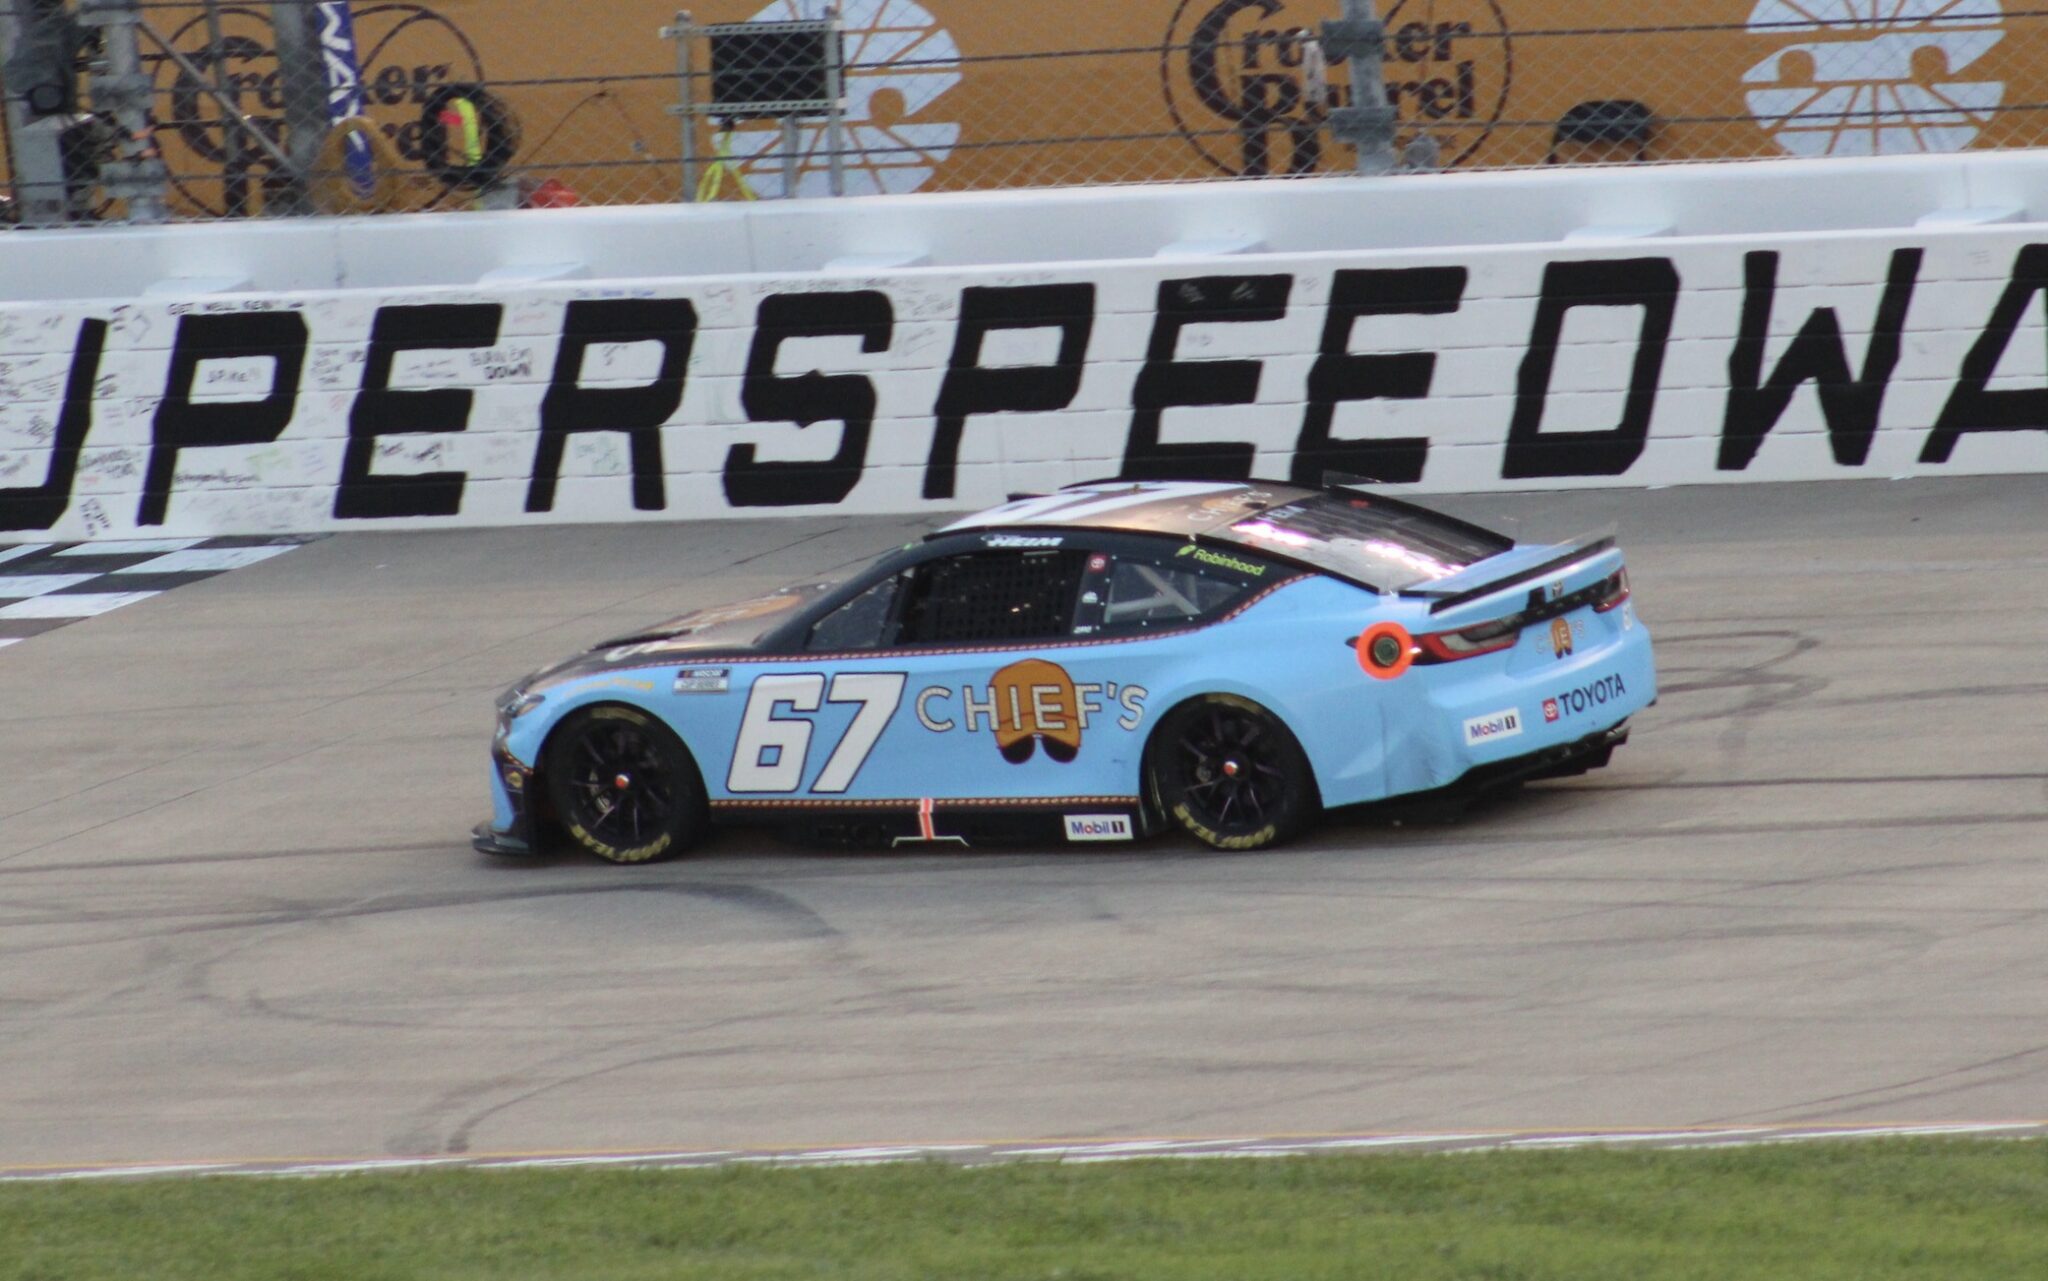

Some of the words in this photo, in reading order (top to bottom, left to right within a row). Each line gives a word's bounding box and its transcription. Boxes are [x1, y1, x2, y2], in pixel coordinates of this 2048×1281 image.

[1188, 0, 1472, 122] Craer
[172, 35, 453, 163] Craer
[1193, 548, 1266, 577] Robinhood
[915, 682, 1149, 733] CHIEF'S
[1559, 673, 1627, 717] TOYOTA
[725, 671, 909, 794] 67
[1470, 718, 1505, 739] Mobil
[1071, 820, 1110, 835] Mobil
